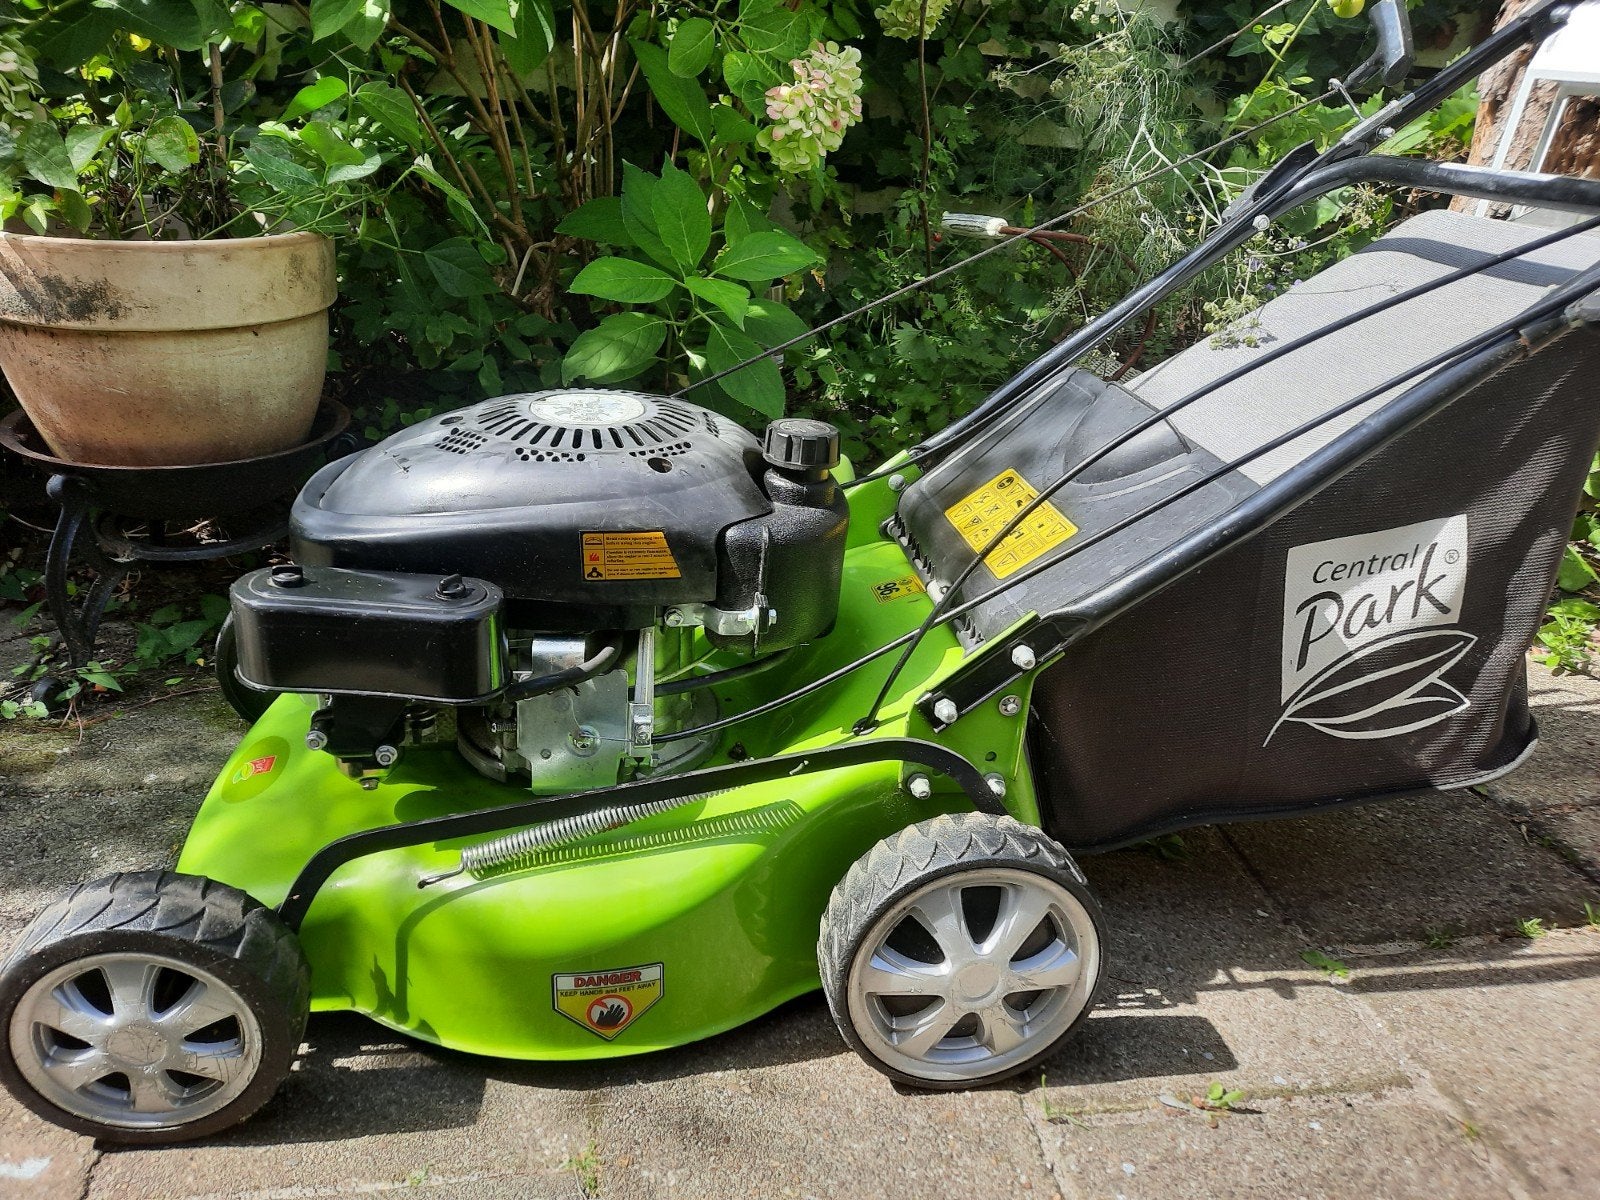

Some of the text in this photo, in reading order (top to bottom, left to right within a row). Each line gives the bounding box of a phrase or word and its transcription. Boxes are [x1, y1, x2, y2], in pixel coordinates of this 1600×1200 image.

[1312, 543, 1420, 584] Central
[1295, 542, 1452, 673] Park
[573, 970, 642, 988] DANGER
